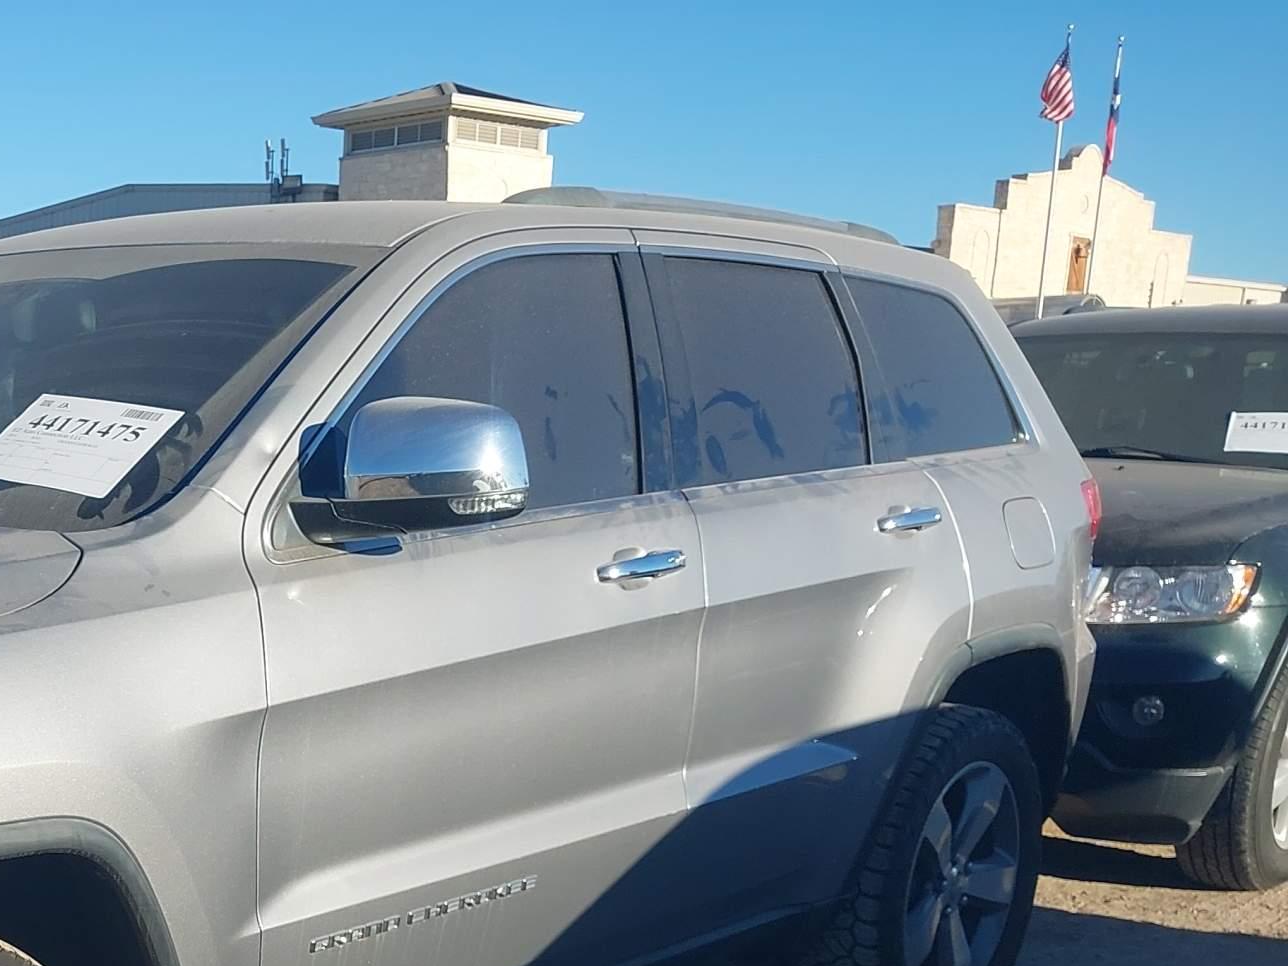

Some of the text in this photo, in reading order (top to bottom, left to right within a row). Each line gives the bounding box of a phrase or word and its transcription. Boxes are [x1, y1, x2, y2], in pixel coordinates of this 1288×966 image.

[28, 413, 147, 442] 44171475
[309, 874, 538, 955] GRAND CHEROKEE
